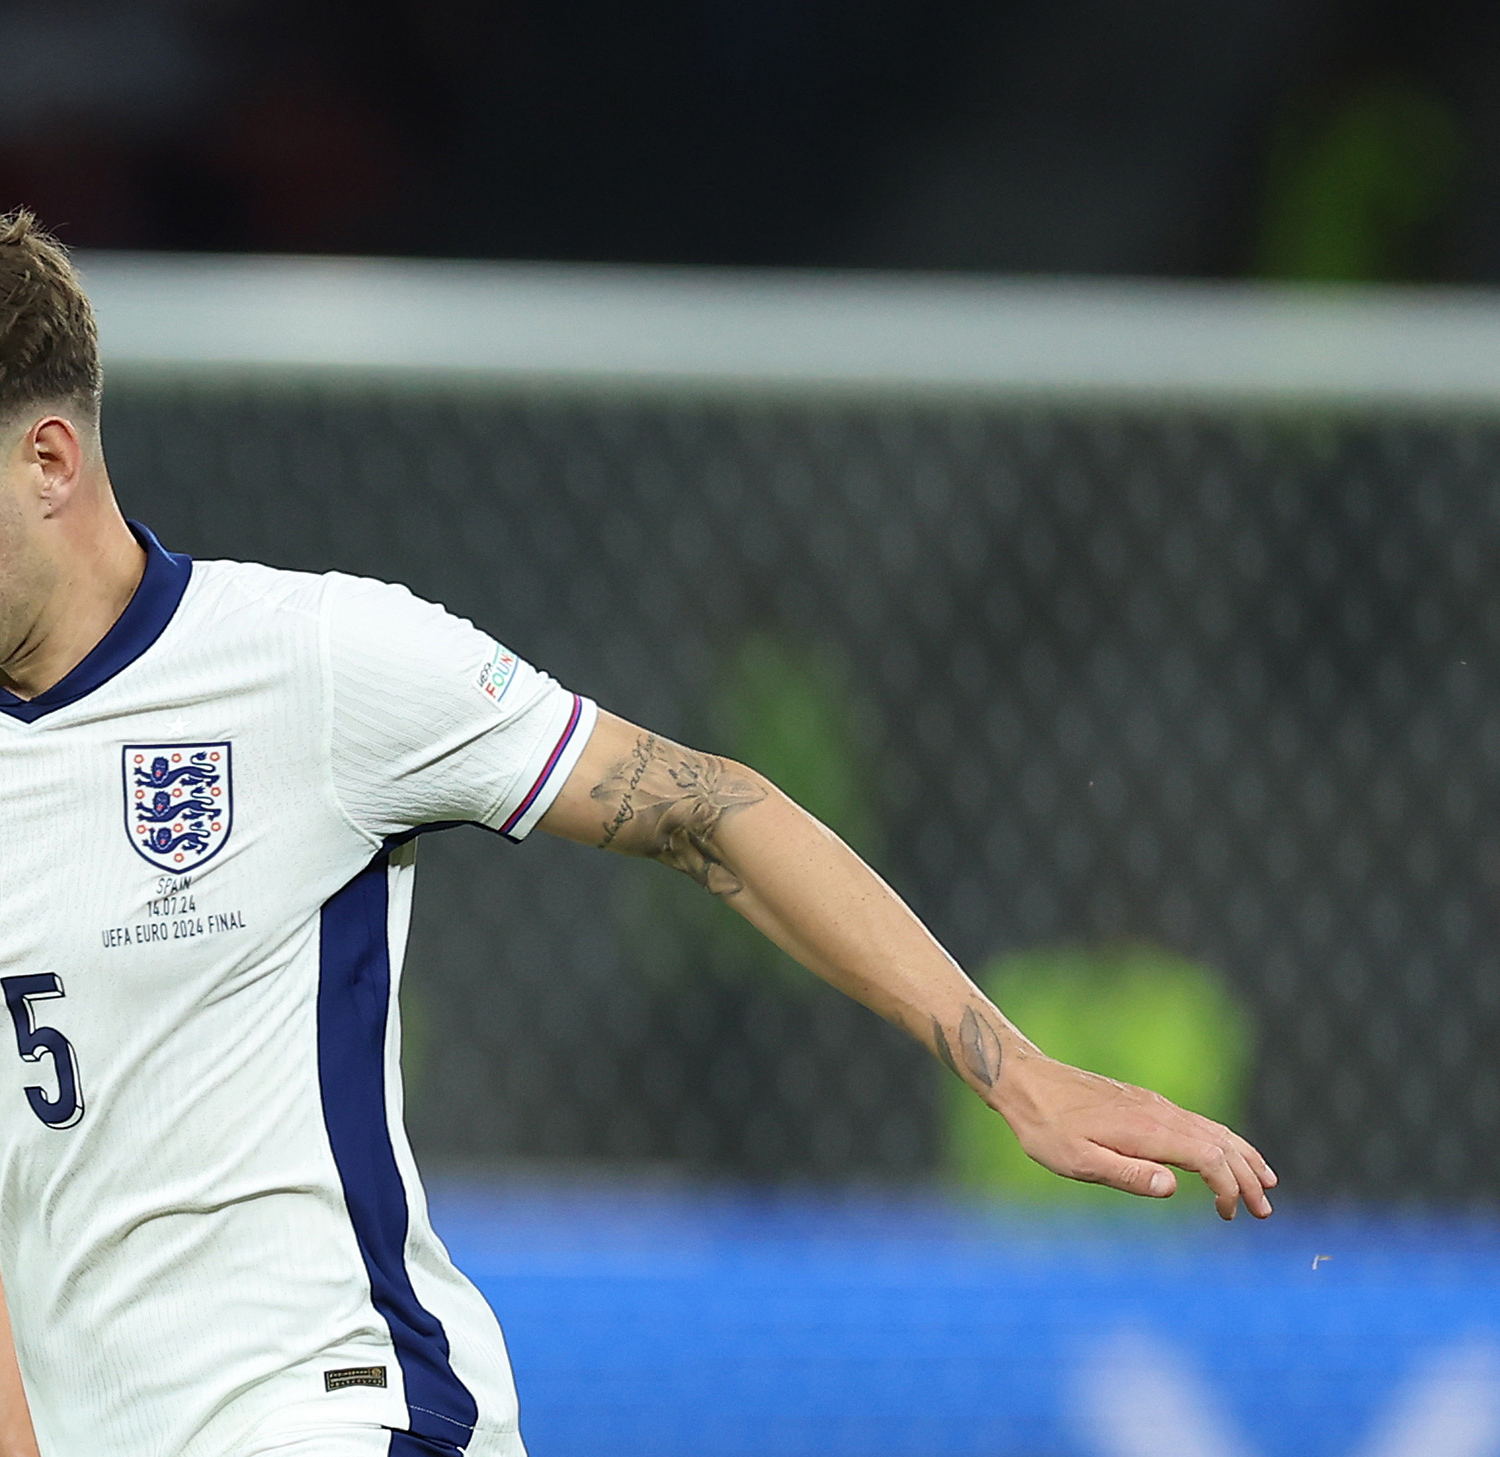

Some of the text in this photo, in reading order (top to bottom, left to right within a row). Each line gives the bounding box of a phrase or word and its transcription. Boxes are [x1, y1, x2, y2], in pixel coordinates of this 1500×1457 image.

[484, 648, 515, 699] FOUN
[156, 876, 192, 895] SPAIN
[146, 895, 197, 918] 14.07.24
[101, 910, 247, 948] UEFA EURO 2024 FINAL
[0, 972, 85, 1130] 5
